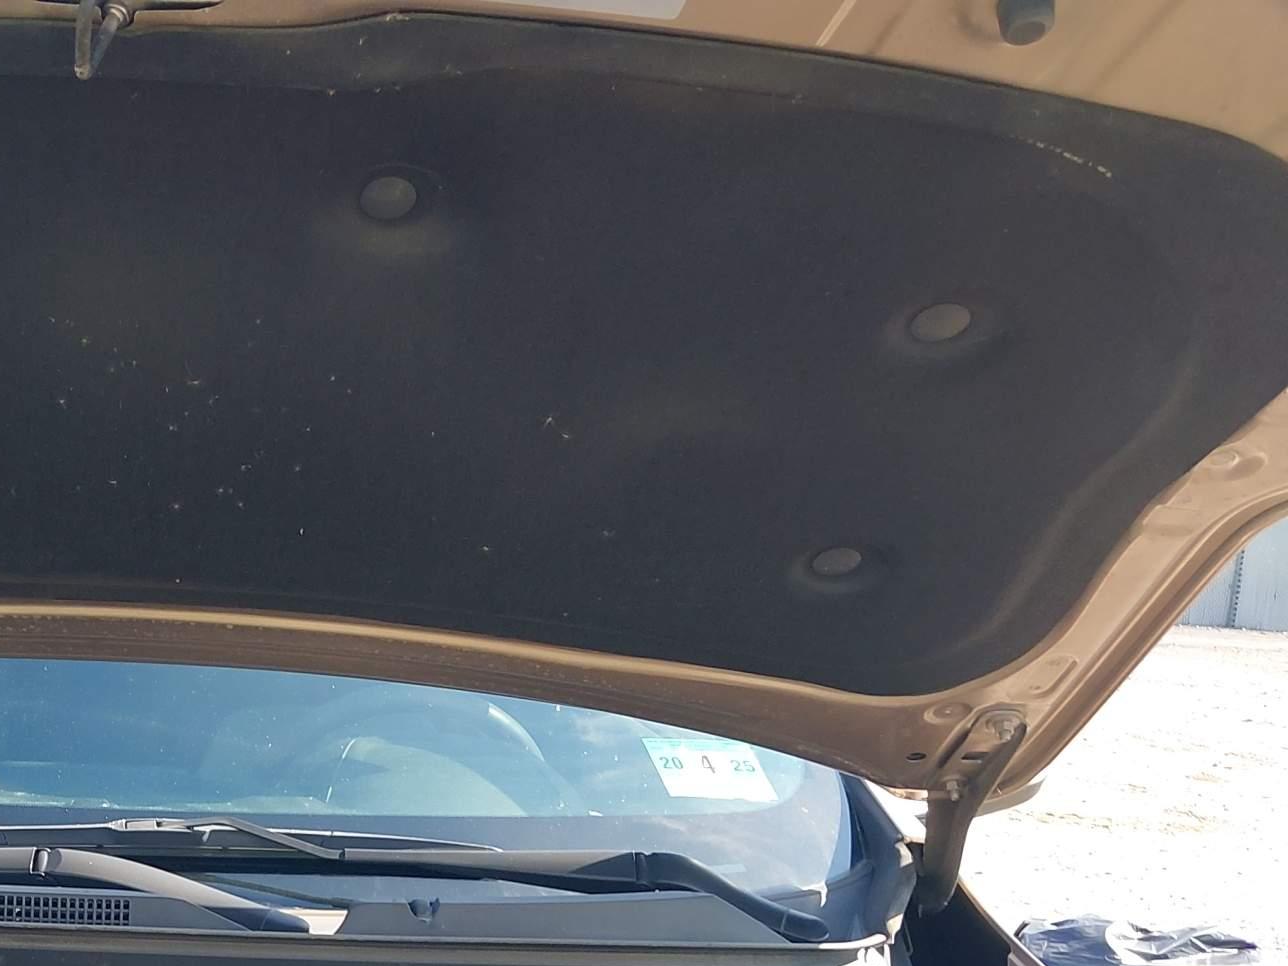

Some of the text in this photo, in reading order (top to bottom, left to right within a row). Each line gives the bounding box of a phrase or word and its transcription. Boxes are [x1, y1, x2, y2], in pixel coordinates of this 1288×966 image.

[659, 754, 756, 774] 20 4 25
